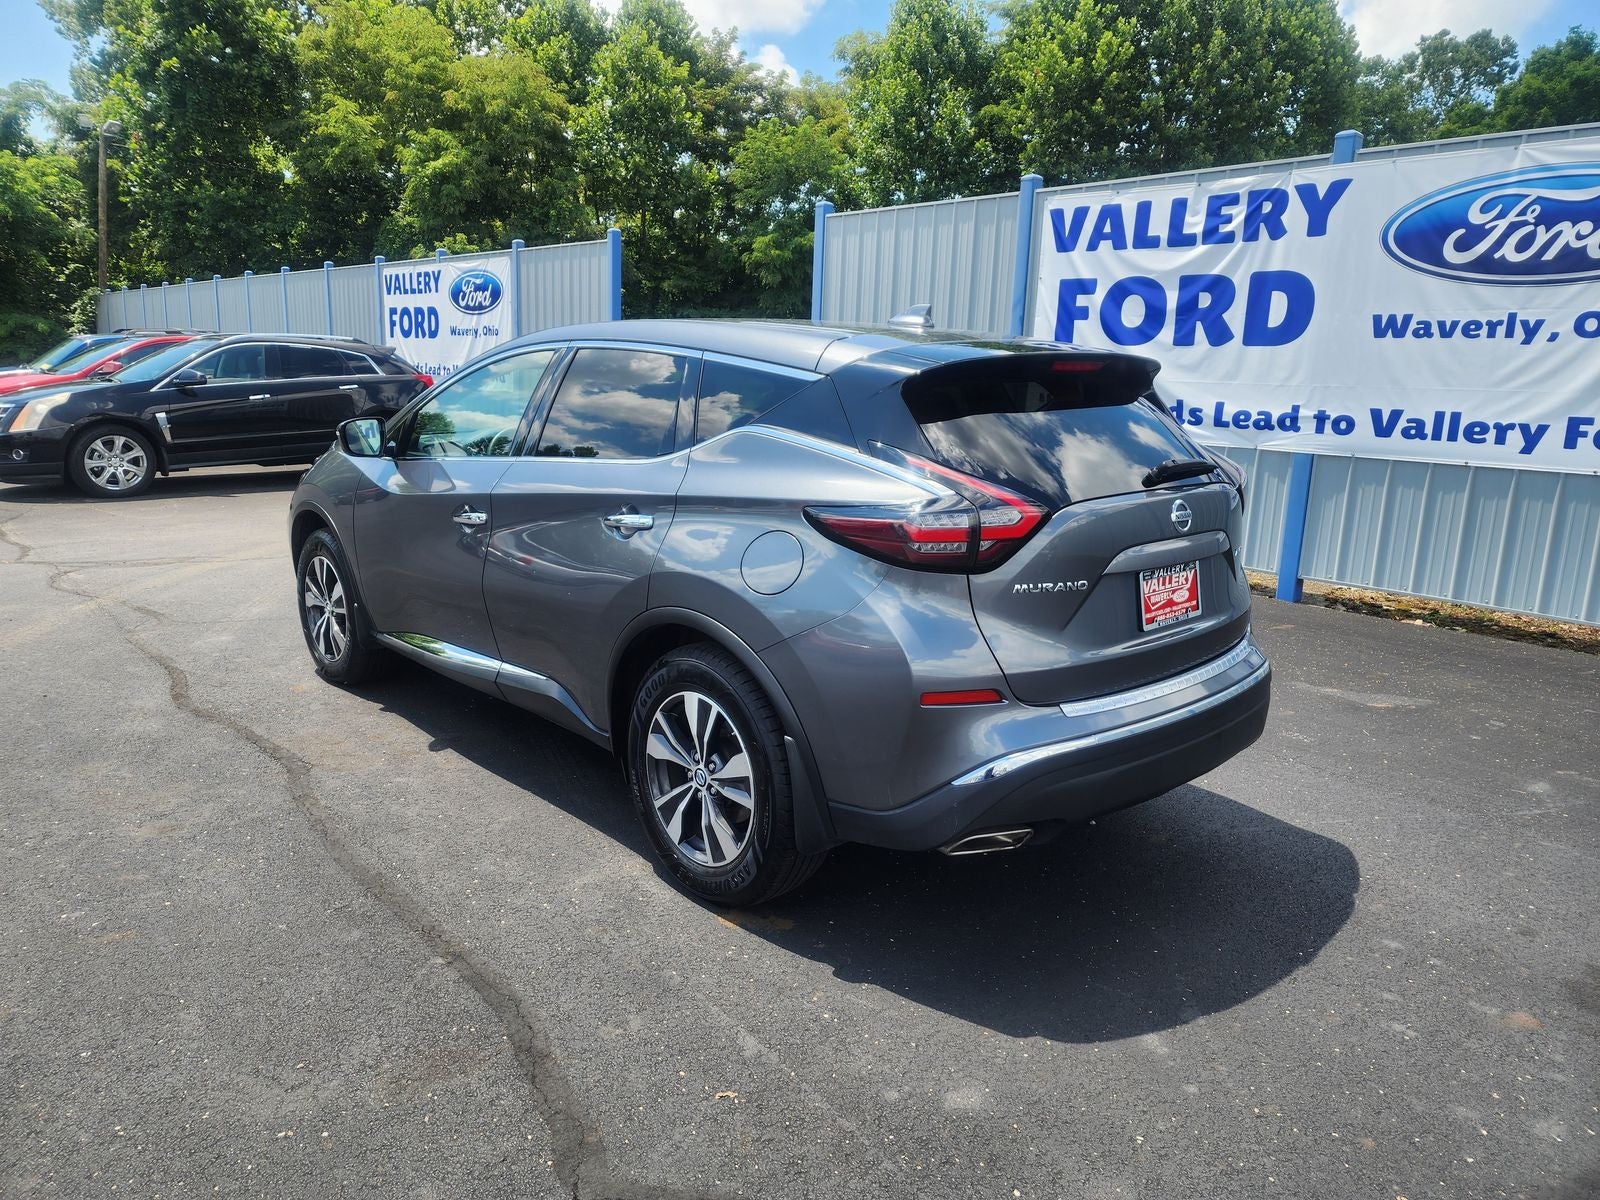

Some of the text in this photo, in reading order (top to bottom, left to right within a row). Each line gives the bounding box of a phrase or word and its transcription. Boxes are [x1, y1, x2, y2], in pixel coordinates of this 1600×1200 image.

[1050, 179, 1353, 253] VALLERY
[1443, 187, 1600, 264] For
[384, 270, 442, 295] VALLERY
[459, 277, 492, 306] Ford
[1055, 269, 1315, 346] FORD
[388, 306, 440, 339] FORD
[482, 325, 499, 336] Ohio
[1372, 312, 1560, 345] Waverly,
[425, 362, 441, 376] Lead
[443, 365, 451, 376] to
[1213, 402, 1301, 432] Lead
[1313, 410, 1355, 436] to
[1370, 408, 1550, 455] Vallery
[1563, 416, 1600, 450] F
[1143, 569, 1195, 593] VALLERY
[1154, 564, 1185, 578] VALLERY
[1012, 580, 1088, 594] MURANO
